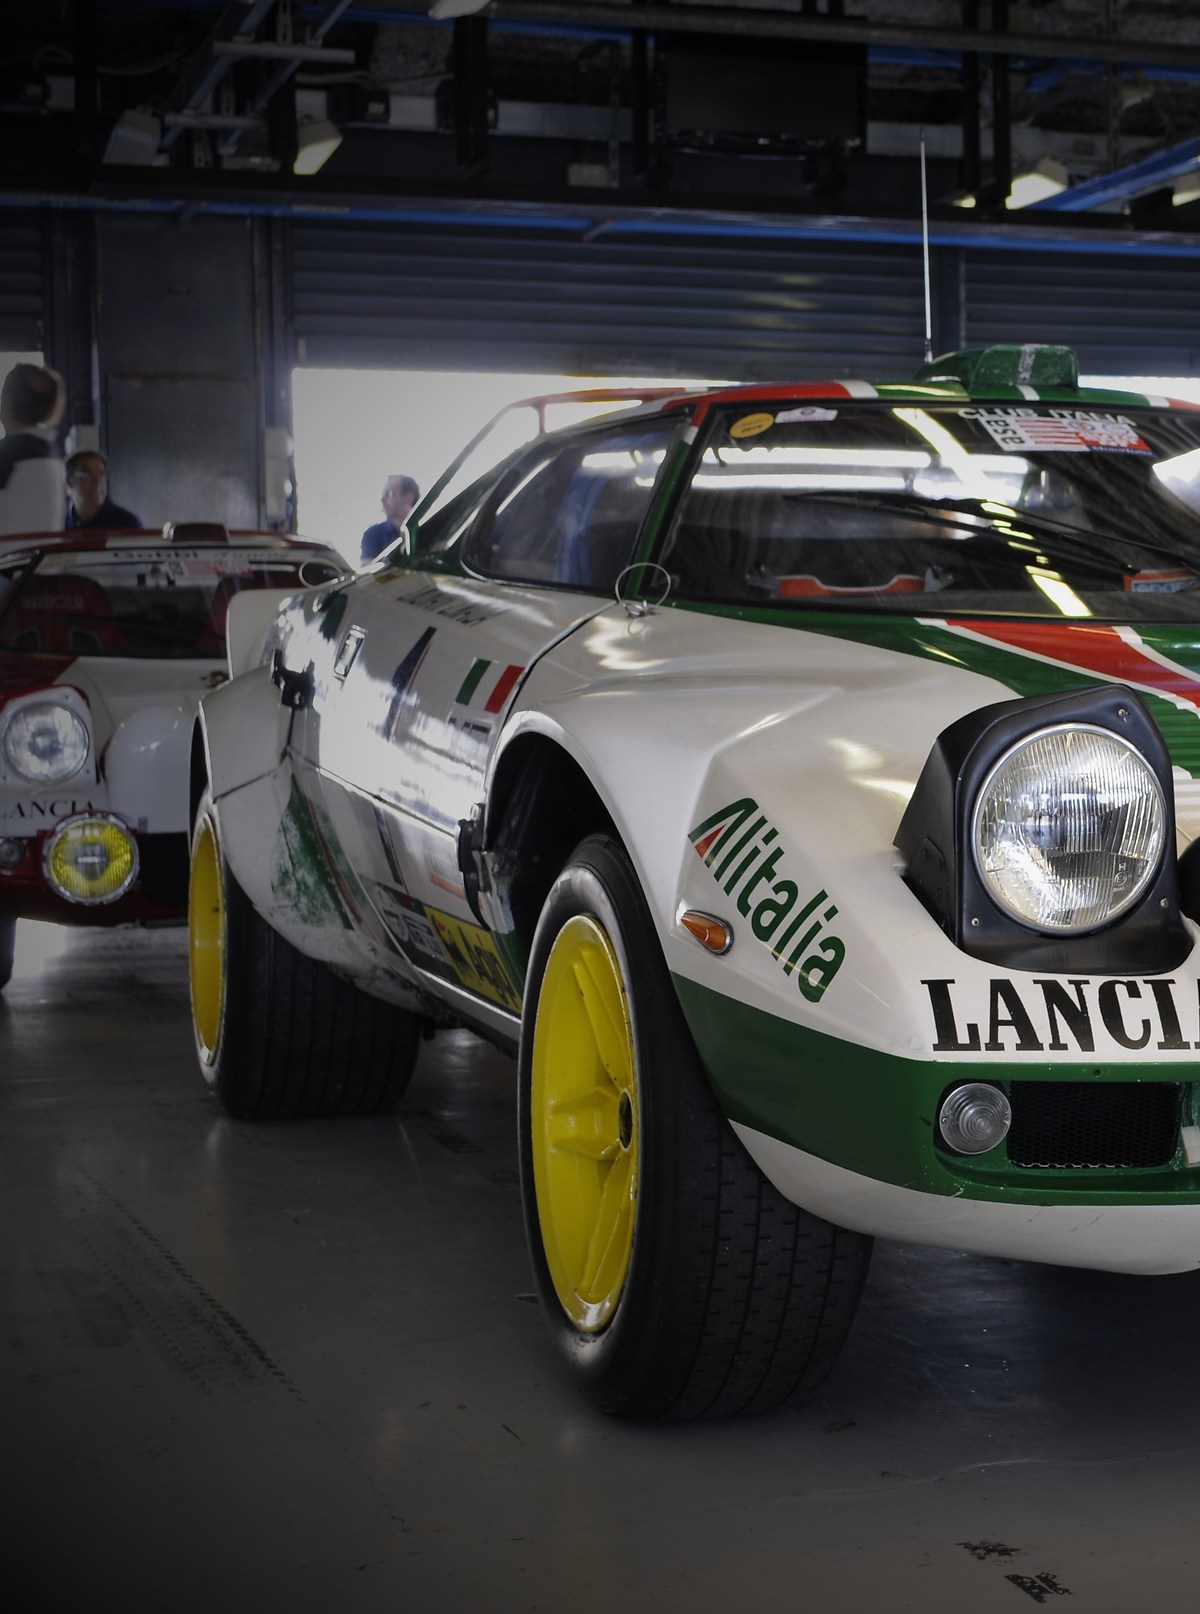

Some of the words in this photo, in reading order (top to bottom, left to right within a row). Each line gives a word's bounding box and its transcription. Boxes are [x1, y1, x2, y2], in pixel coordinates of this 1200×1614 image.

[958, 408, 1039, 420] CLUB
[1049, 408, 1137, 427] ITALIA
[688, 797, 846, 1003] Alitalia
